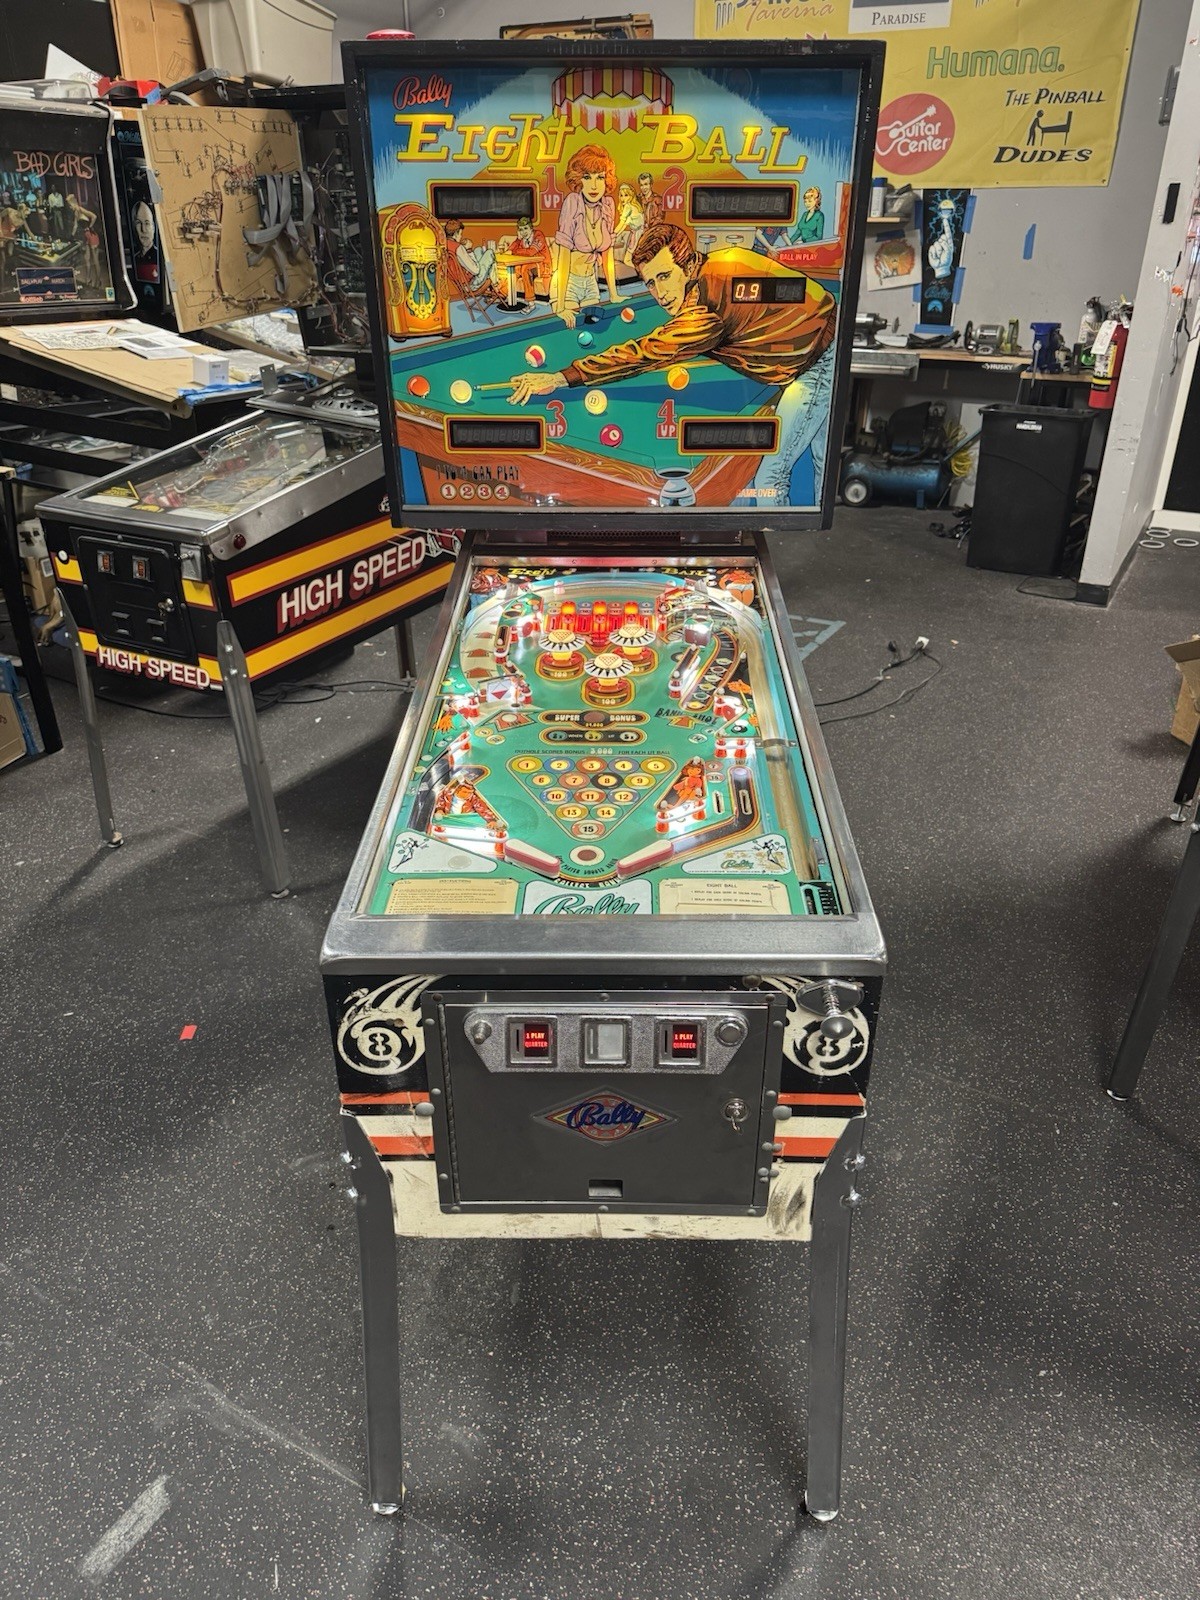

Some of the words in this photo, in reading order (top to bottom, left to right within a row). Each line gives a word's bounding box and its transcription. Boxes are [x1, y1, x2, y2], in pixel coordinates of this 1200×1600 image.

[746, 1, 834, 31] Taverna
[872, 12, 926, 25] PARADISE
[393, 74, 452, 110] Bally
[1005, 90, 1030, 106] THE
[1034, 88, 1107, 105] PINBALL
[889, 118, 941, 139] Guitar
[640, 114, 808, 173] BALL
[898, 136, 949, 156] Center
[993, 147, 1093, 163] DUDES
[13, 151, 50, 177] BAD
[53, 152, 94, 179] GIRLS
[663, 166, 686, 195] 2
[543, 194, 560, 208] UP
[667, 195, 683, 209] UP
[780, 253, 794, 261] BALL
[795, 253, 802, 261] IN
[990, 363, 1013, 371] HUSKY
[657, 399, 677, 424] 4
[548, 425, 564, 437] UP
[660, 425, 676, 437] UP
[497, 466, 519, 480] PLAY
[463, 486, 472, 497] 2
[480, 486, 490, 497] 3
[496, 486, 507, 497] 4
[758, 488, 777, 497] OVER
[280, 569, 343, 624] HIGH
[352, 536, 426, 592] SPEED
[98, 644, 142, 673] HIGH
[147, 657, 210, 689] SPEED
[369, 1033, 392, 1056] 8
[673, 1041, 696, 1049] QUARTER
[566, 1101, 646, 1130] Bally
